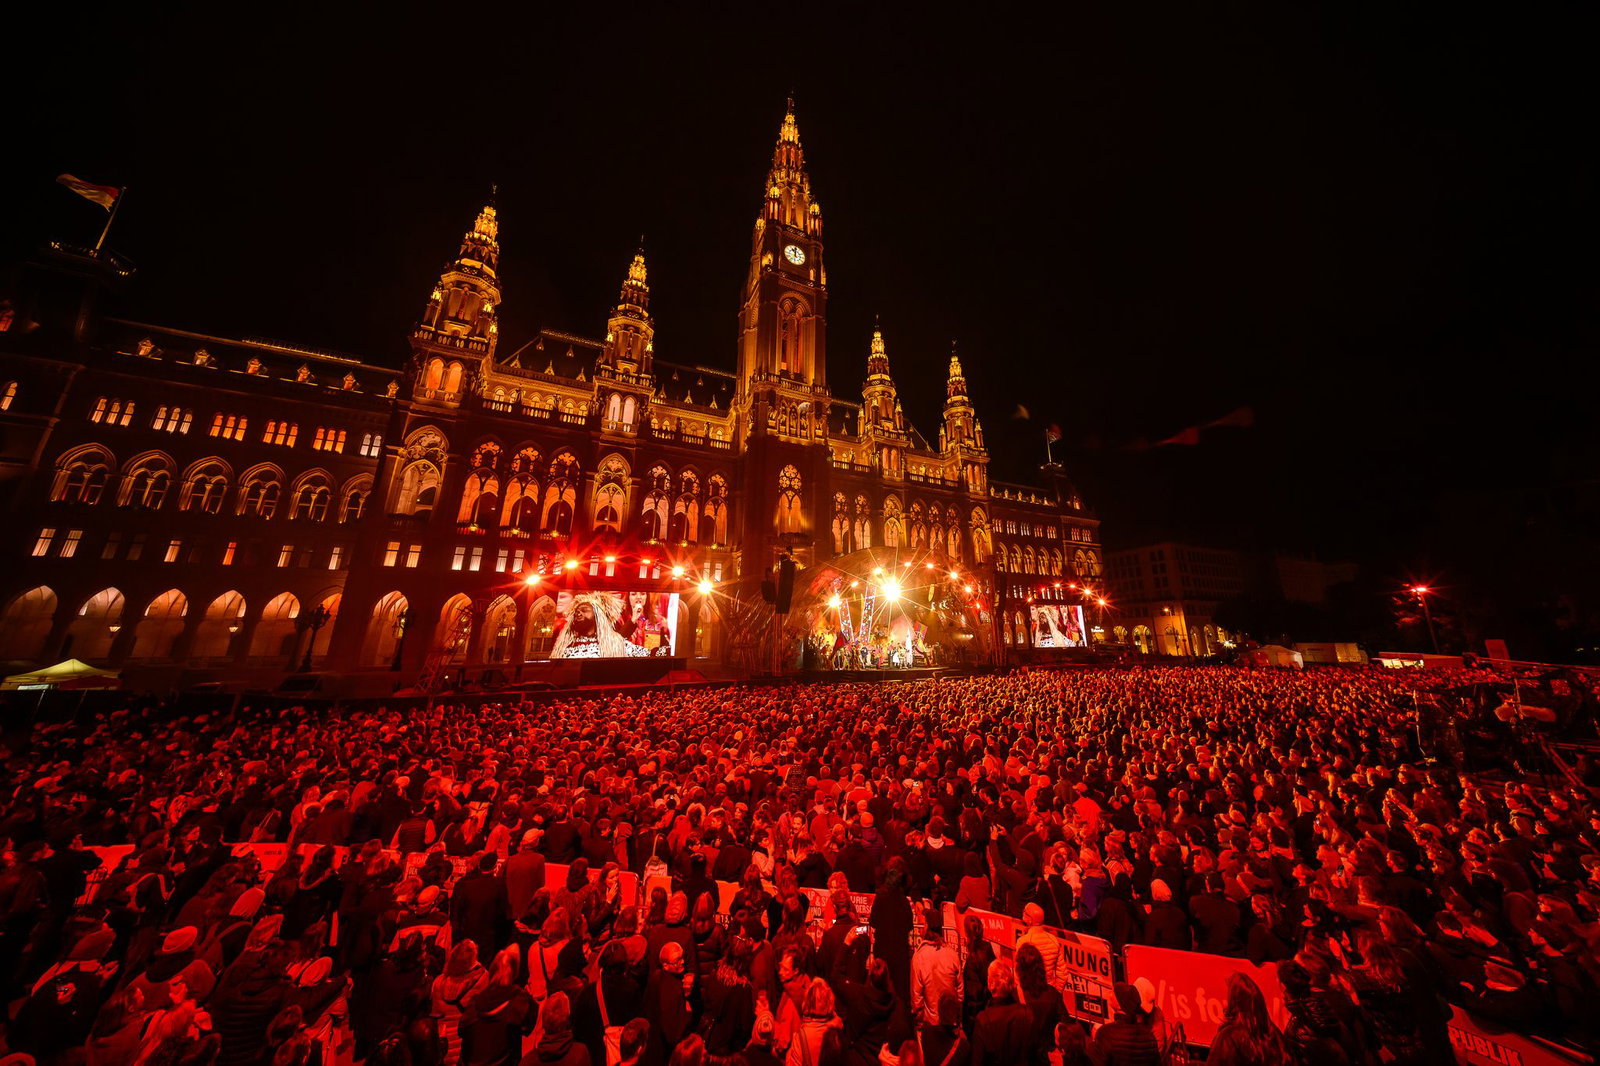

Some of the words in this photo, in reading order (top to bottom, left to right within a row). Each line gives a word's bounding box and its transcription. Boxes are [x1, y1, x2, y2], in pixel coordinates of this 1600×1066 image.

[988, 918, 1005, 930] MAI
[1063, 944, 1109, 977] NUNG
[1169, 985, 1191, 1020] is
[1447, 1025, 1522, 1066] PUBLIK
